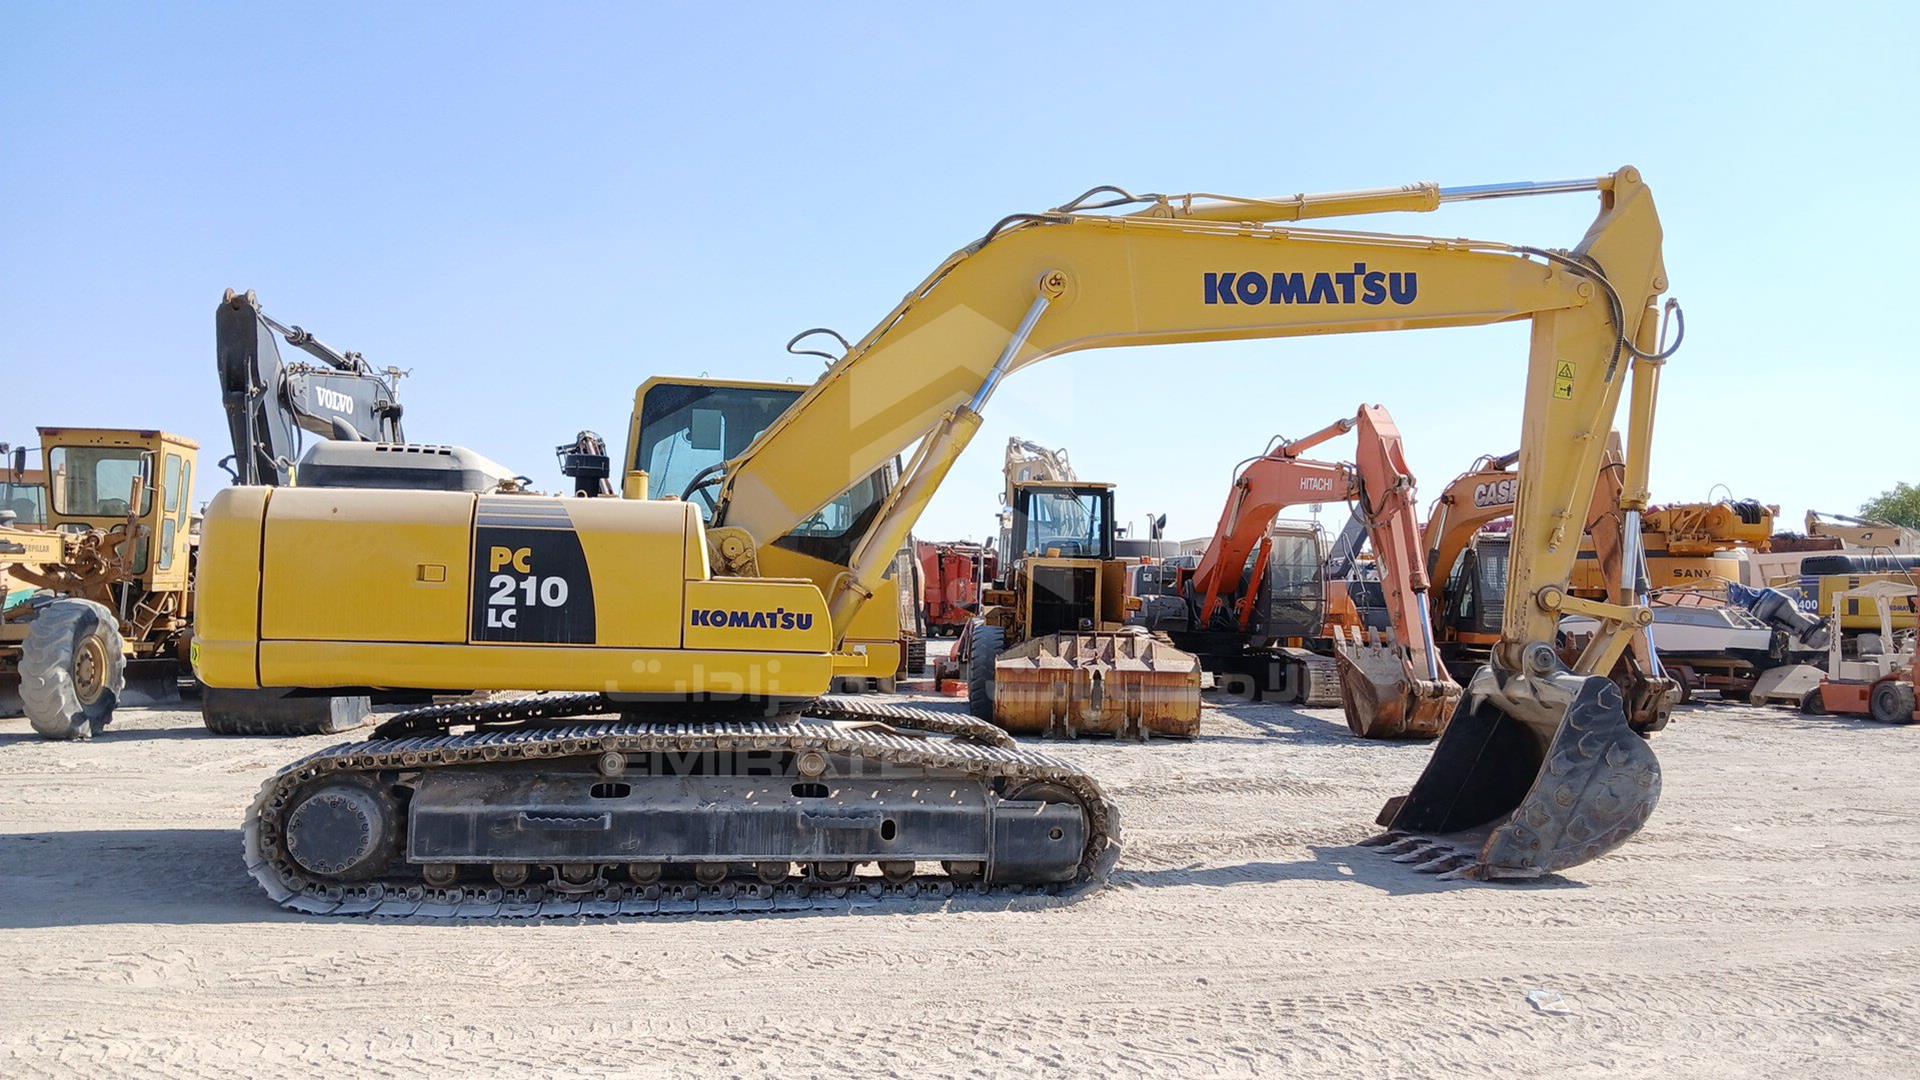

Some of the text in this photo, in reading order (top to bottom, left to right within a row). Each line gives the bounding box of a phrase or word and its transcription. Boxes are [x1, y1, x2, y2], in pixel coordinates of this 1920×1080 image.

[1204, 262, 1418, 305] KOMATSU
[315, 386, 354, 415] VOLVO
[1300, 477, 1333, 491] HITACHI
[490, 546, 532, 574] PC
[1673, 569, 1712, 578] SANY
[488, 574, 569, 607] 210
[1798, 599, 1818, 610] 400
[487, 608, 517, 629] LC
[691, 608, 813, 630] KOMATSU
